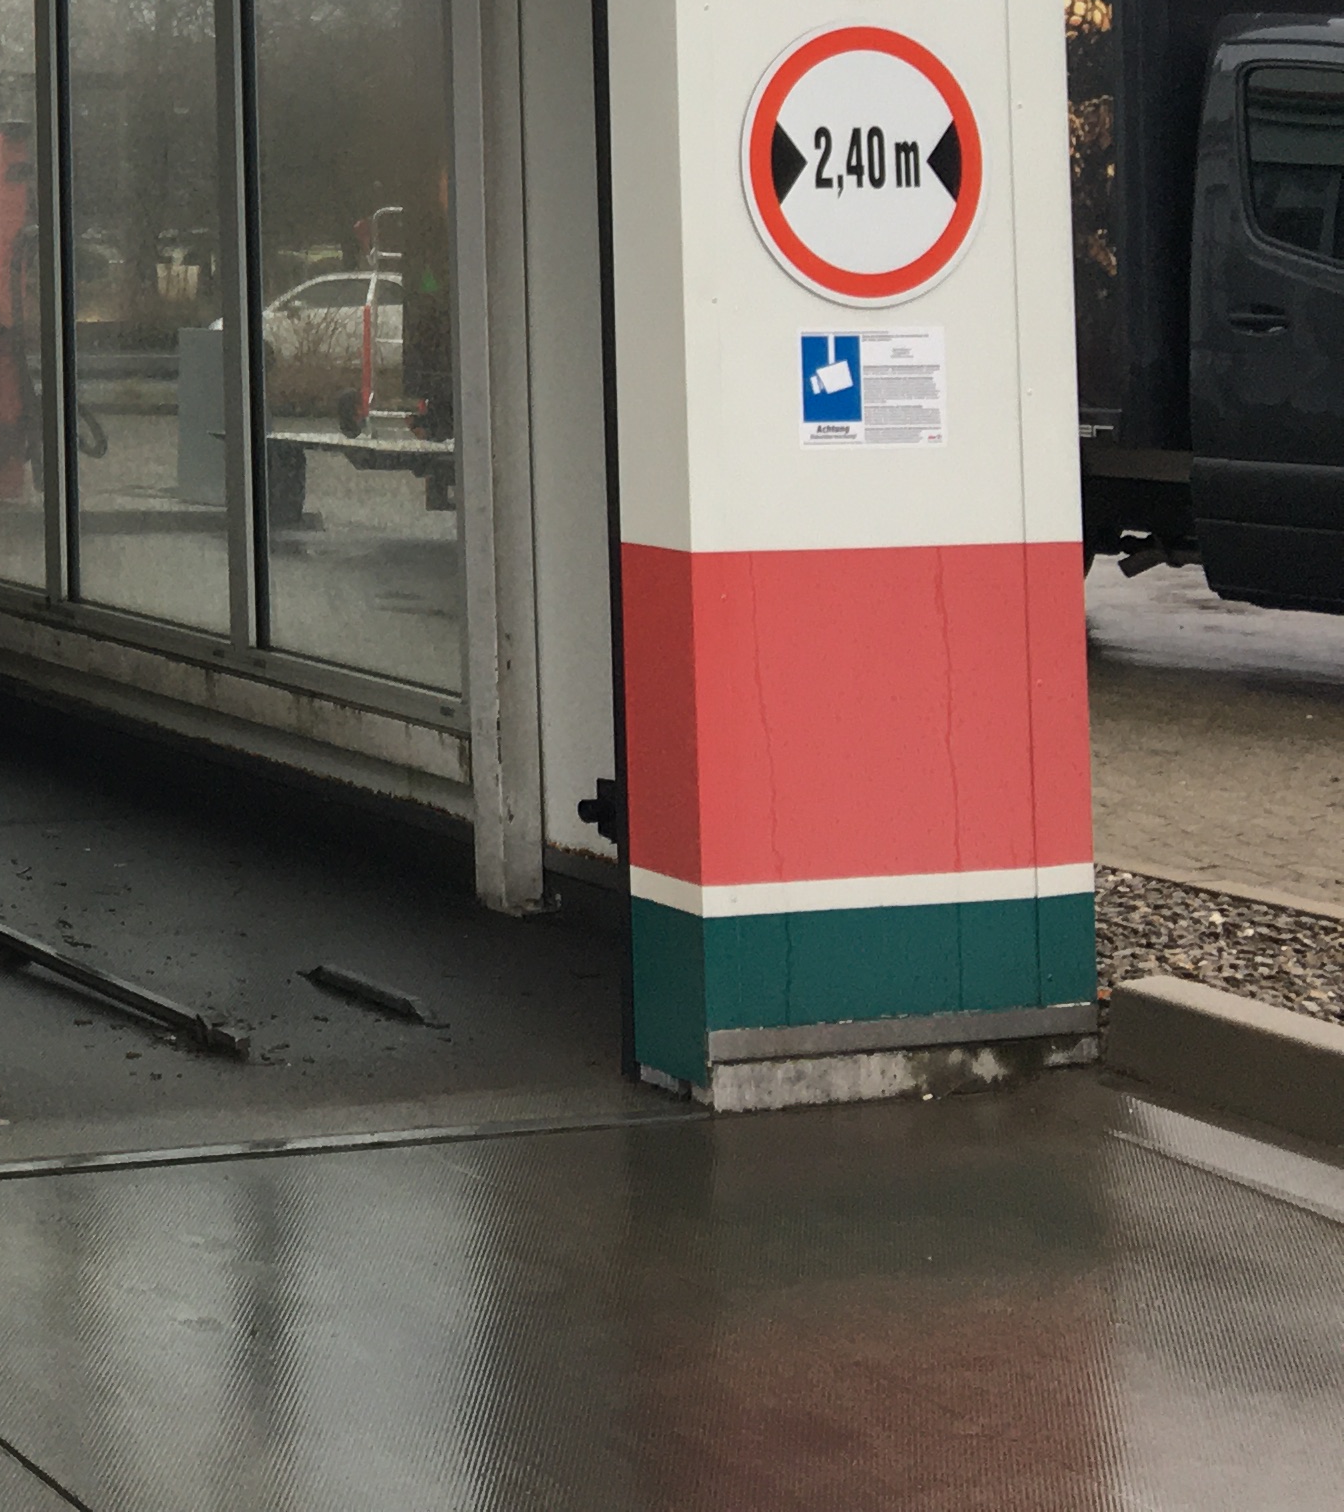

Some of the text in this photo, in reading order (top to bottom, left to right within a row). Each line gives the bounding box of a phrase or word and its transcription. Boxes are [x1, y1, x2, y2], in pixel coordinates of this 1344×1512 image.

[814, 126, 920, 199] 2,40 m
[817, 425, 850, 434] Achtung
